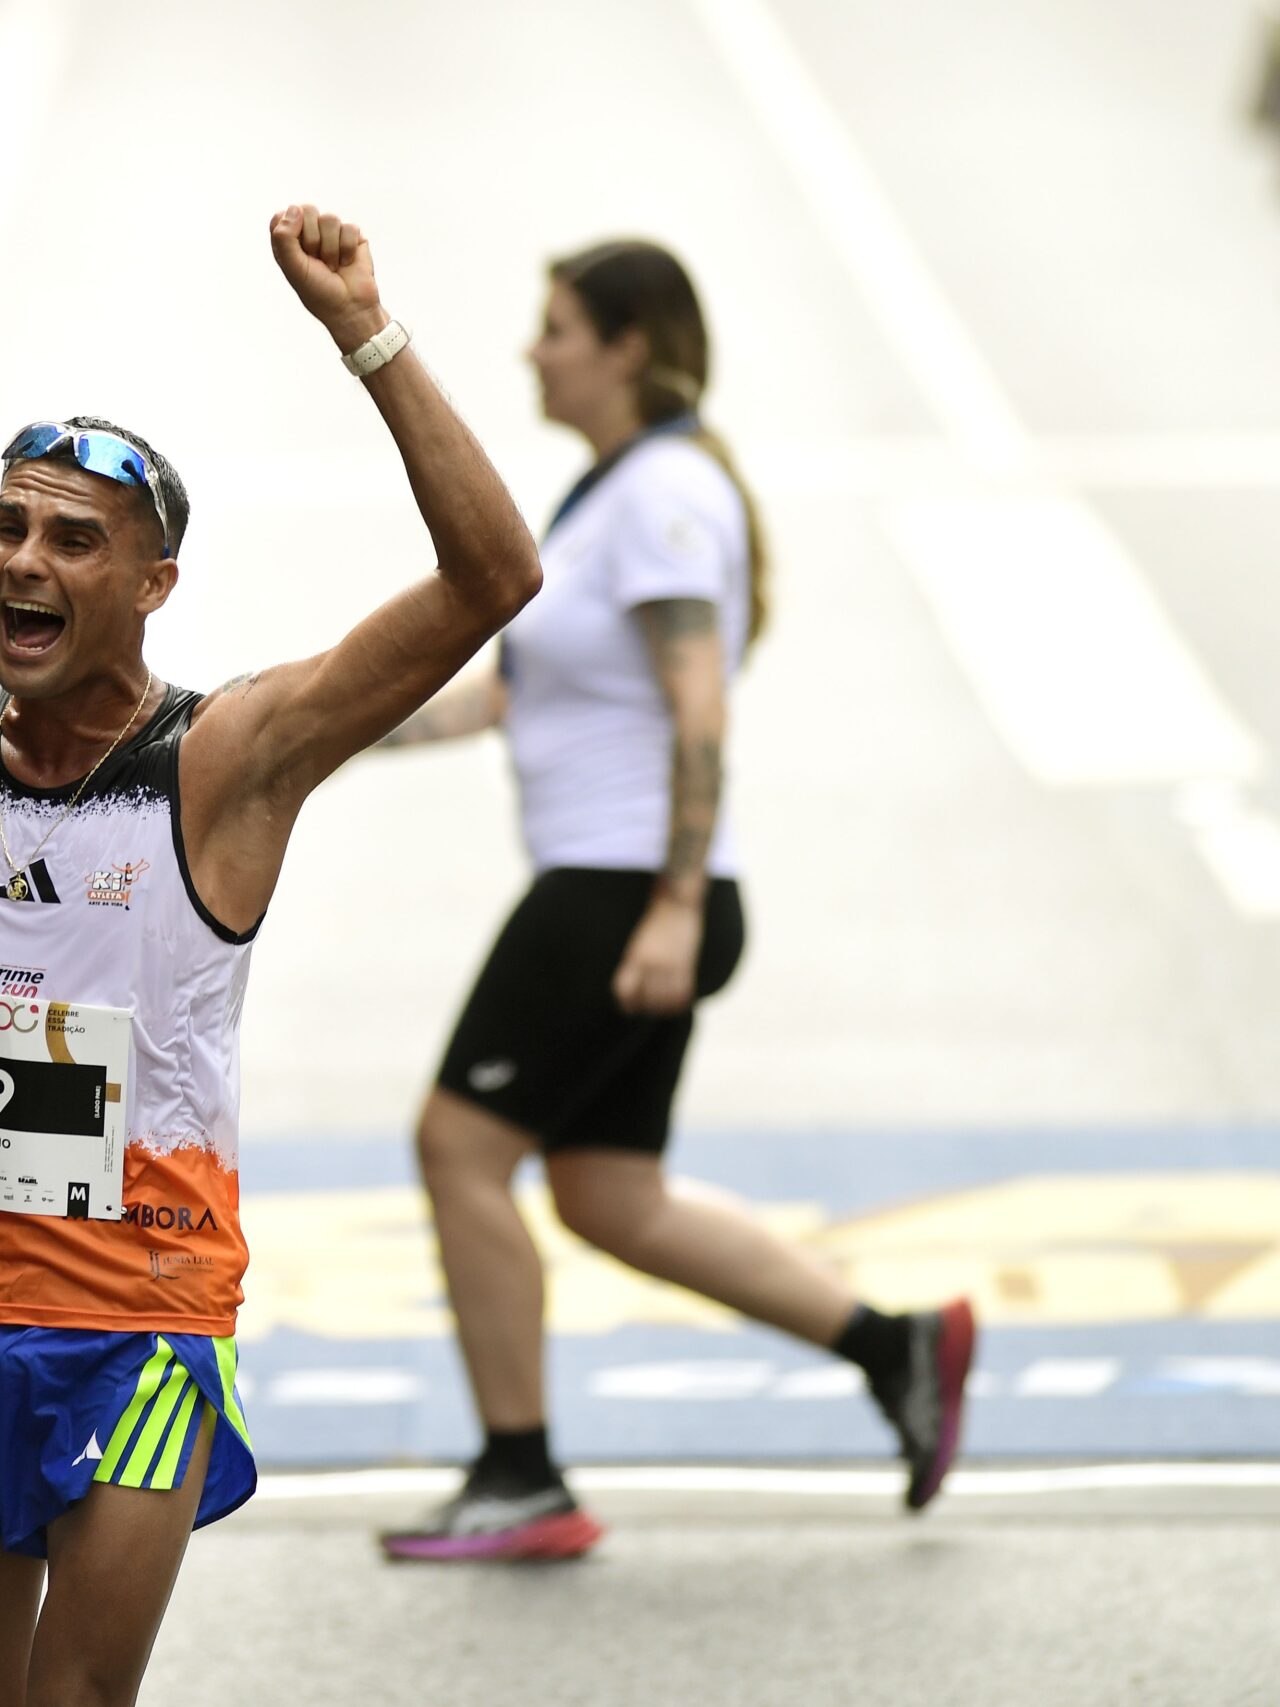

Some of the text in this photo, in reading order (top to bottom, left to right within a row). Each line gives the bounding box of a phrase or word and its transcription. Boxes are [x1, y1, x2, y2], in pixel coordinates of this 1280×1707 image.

[90, 891, 122, 900] ATLETA
[47, 1009, 79, 1018] CELEBRE
[47, 1025, 86, 1035] TRADIÇÃO
[70, 1186, 86, 1201] M
